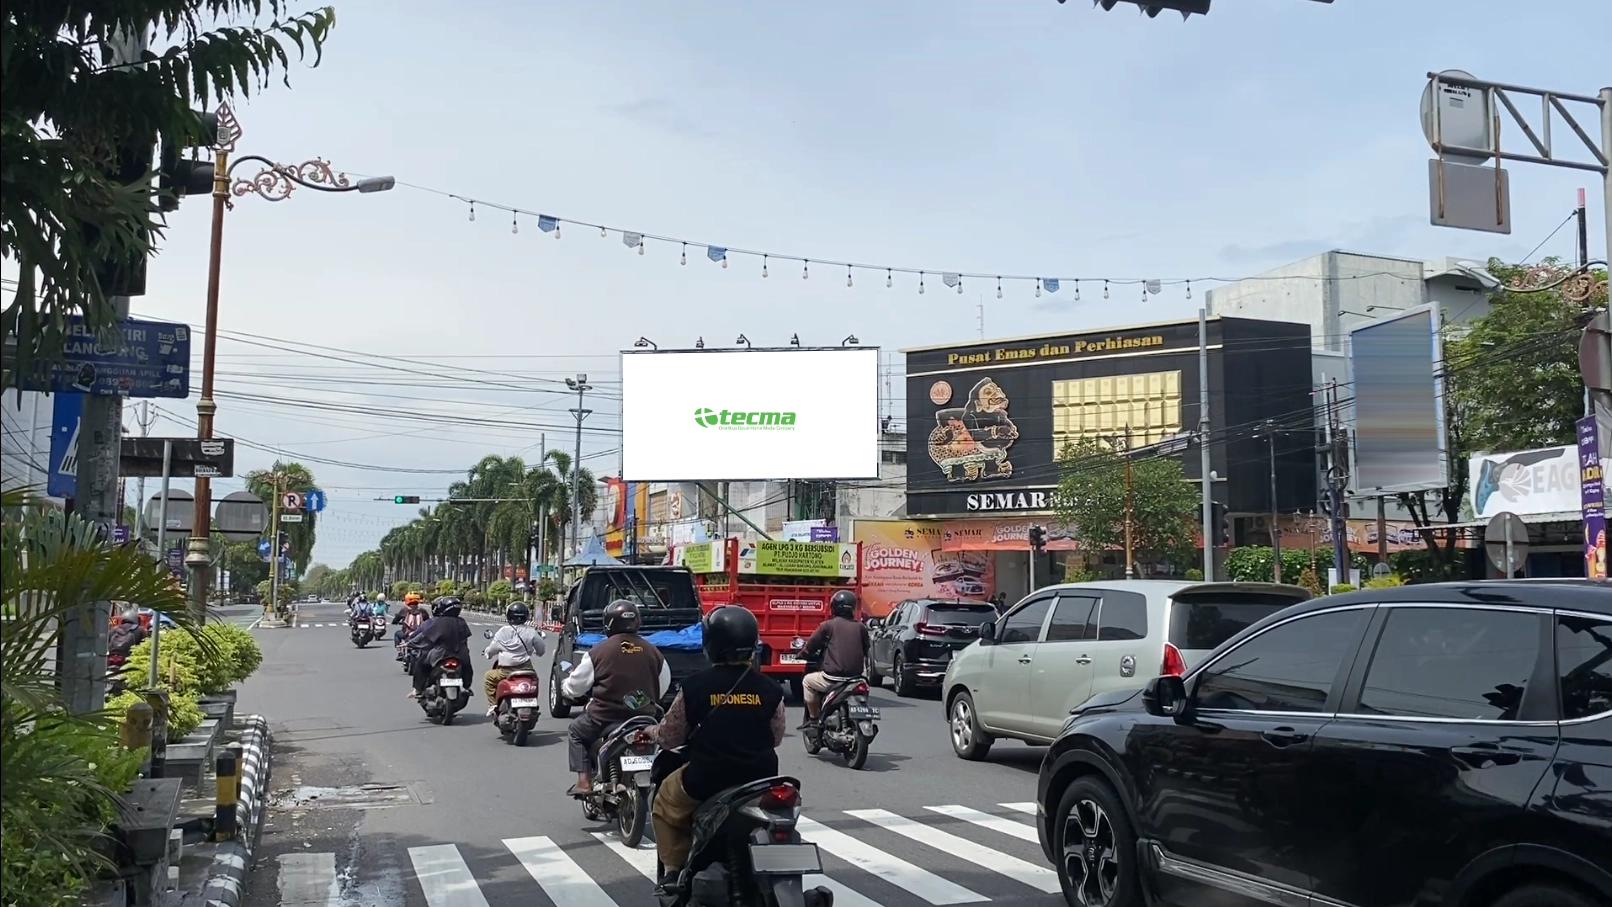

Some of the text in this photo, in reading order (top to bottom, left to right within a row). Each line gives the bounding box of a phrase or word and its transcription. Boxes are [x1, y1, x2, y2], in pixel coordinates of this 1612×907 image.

[947, 335, 1164, 365] Pusat Emas dan Perhiasan
[719, 409, 797, 425] tecma
[966, 492, 1047, 510] SEMAR
[954, 528, 982, 536] SEMAR
[762, 543, 777, 551] AGEN
[778, 543, 789, 551] LPG
[790, 543, 794, 551] 3
[804, 544, 834, 553] BERSUBSIDI
[870, 547, 919, 560] GOLDEN
[864, 557, 925, 572] JOURNEY!
[710, 693, 762, 706] INDONESIA
